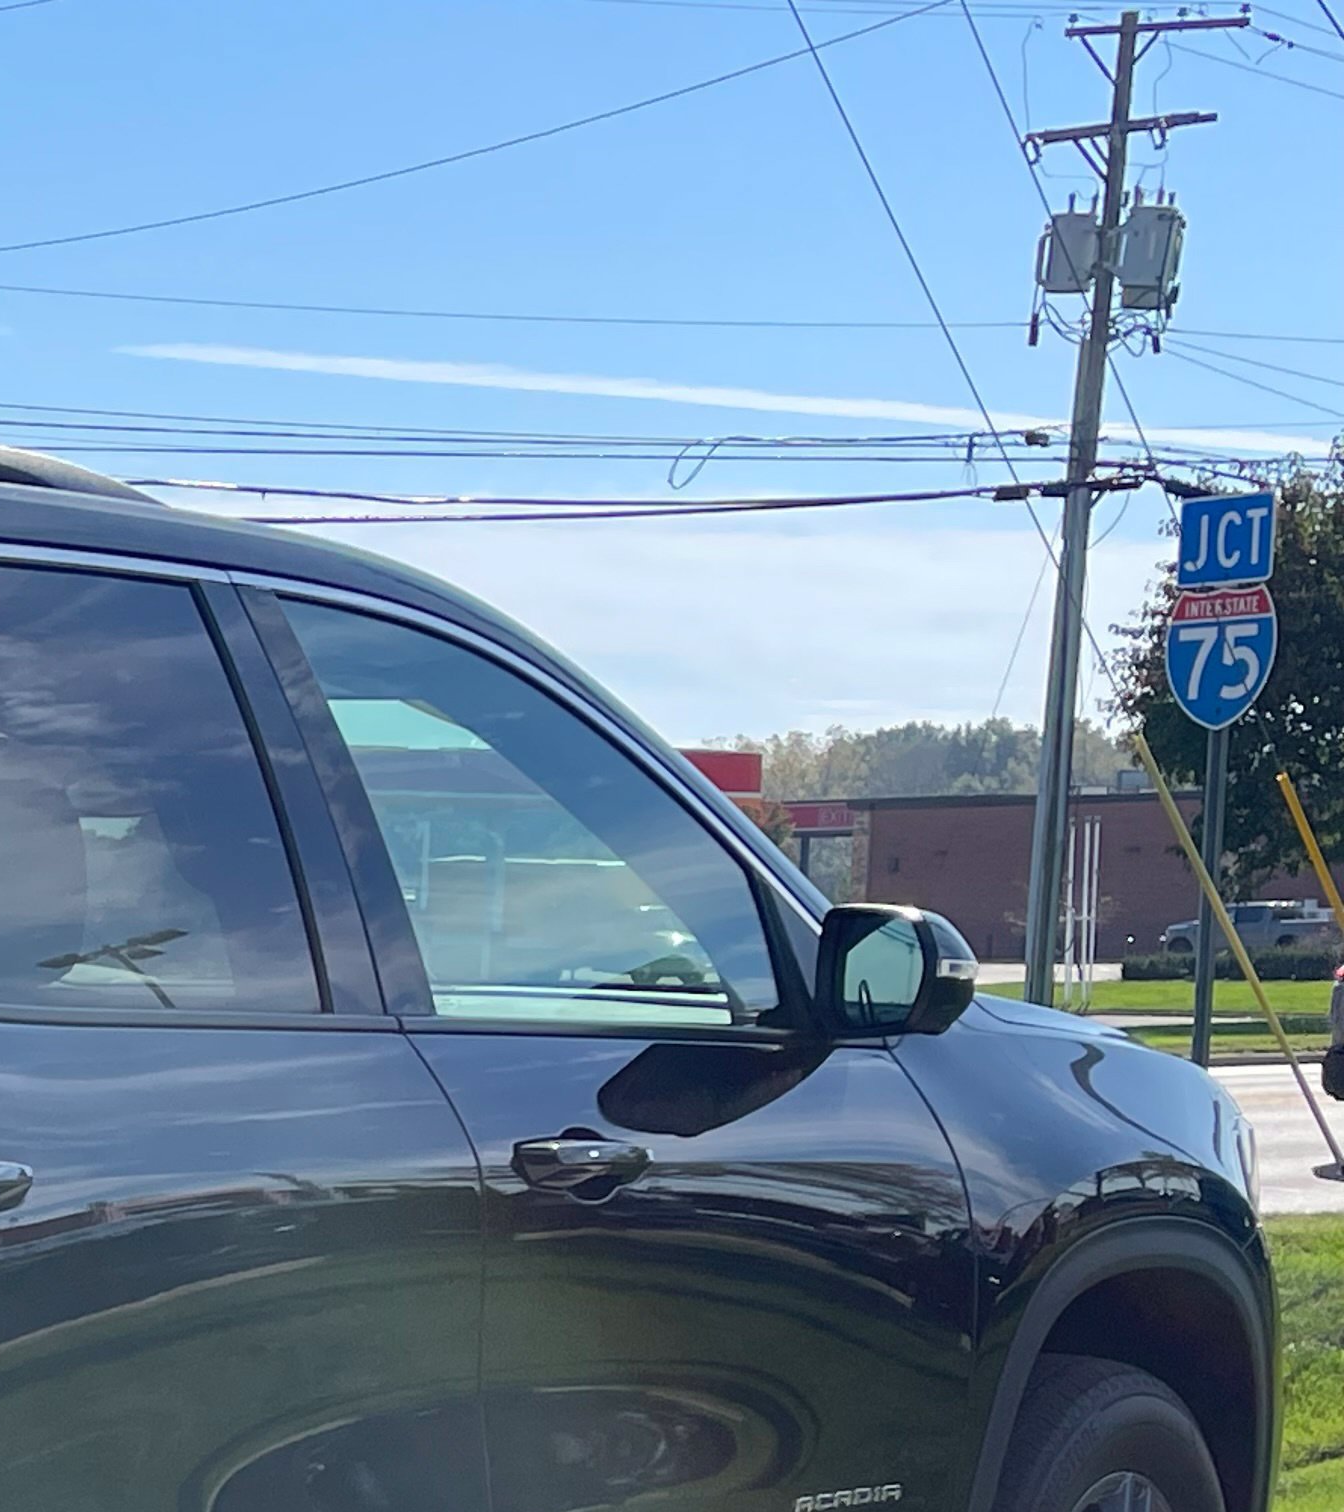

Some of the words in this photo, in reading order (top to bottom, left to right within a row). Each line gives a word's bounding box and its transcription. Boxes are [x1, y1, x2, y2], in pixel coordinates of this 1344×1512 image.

[1183, 507, 1269, 573] JCT
[1184, 594, 1261, 619] INTERSTATE
[1178, 622, 1260, 701] 75
